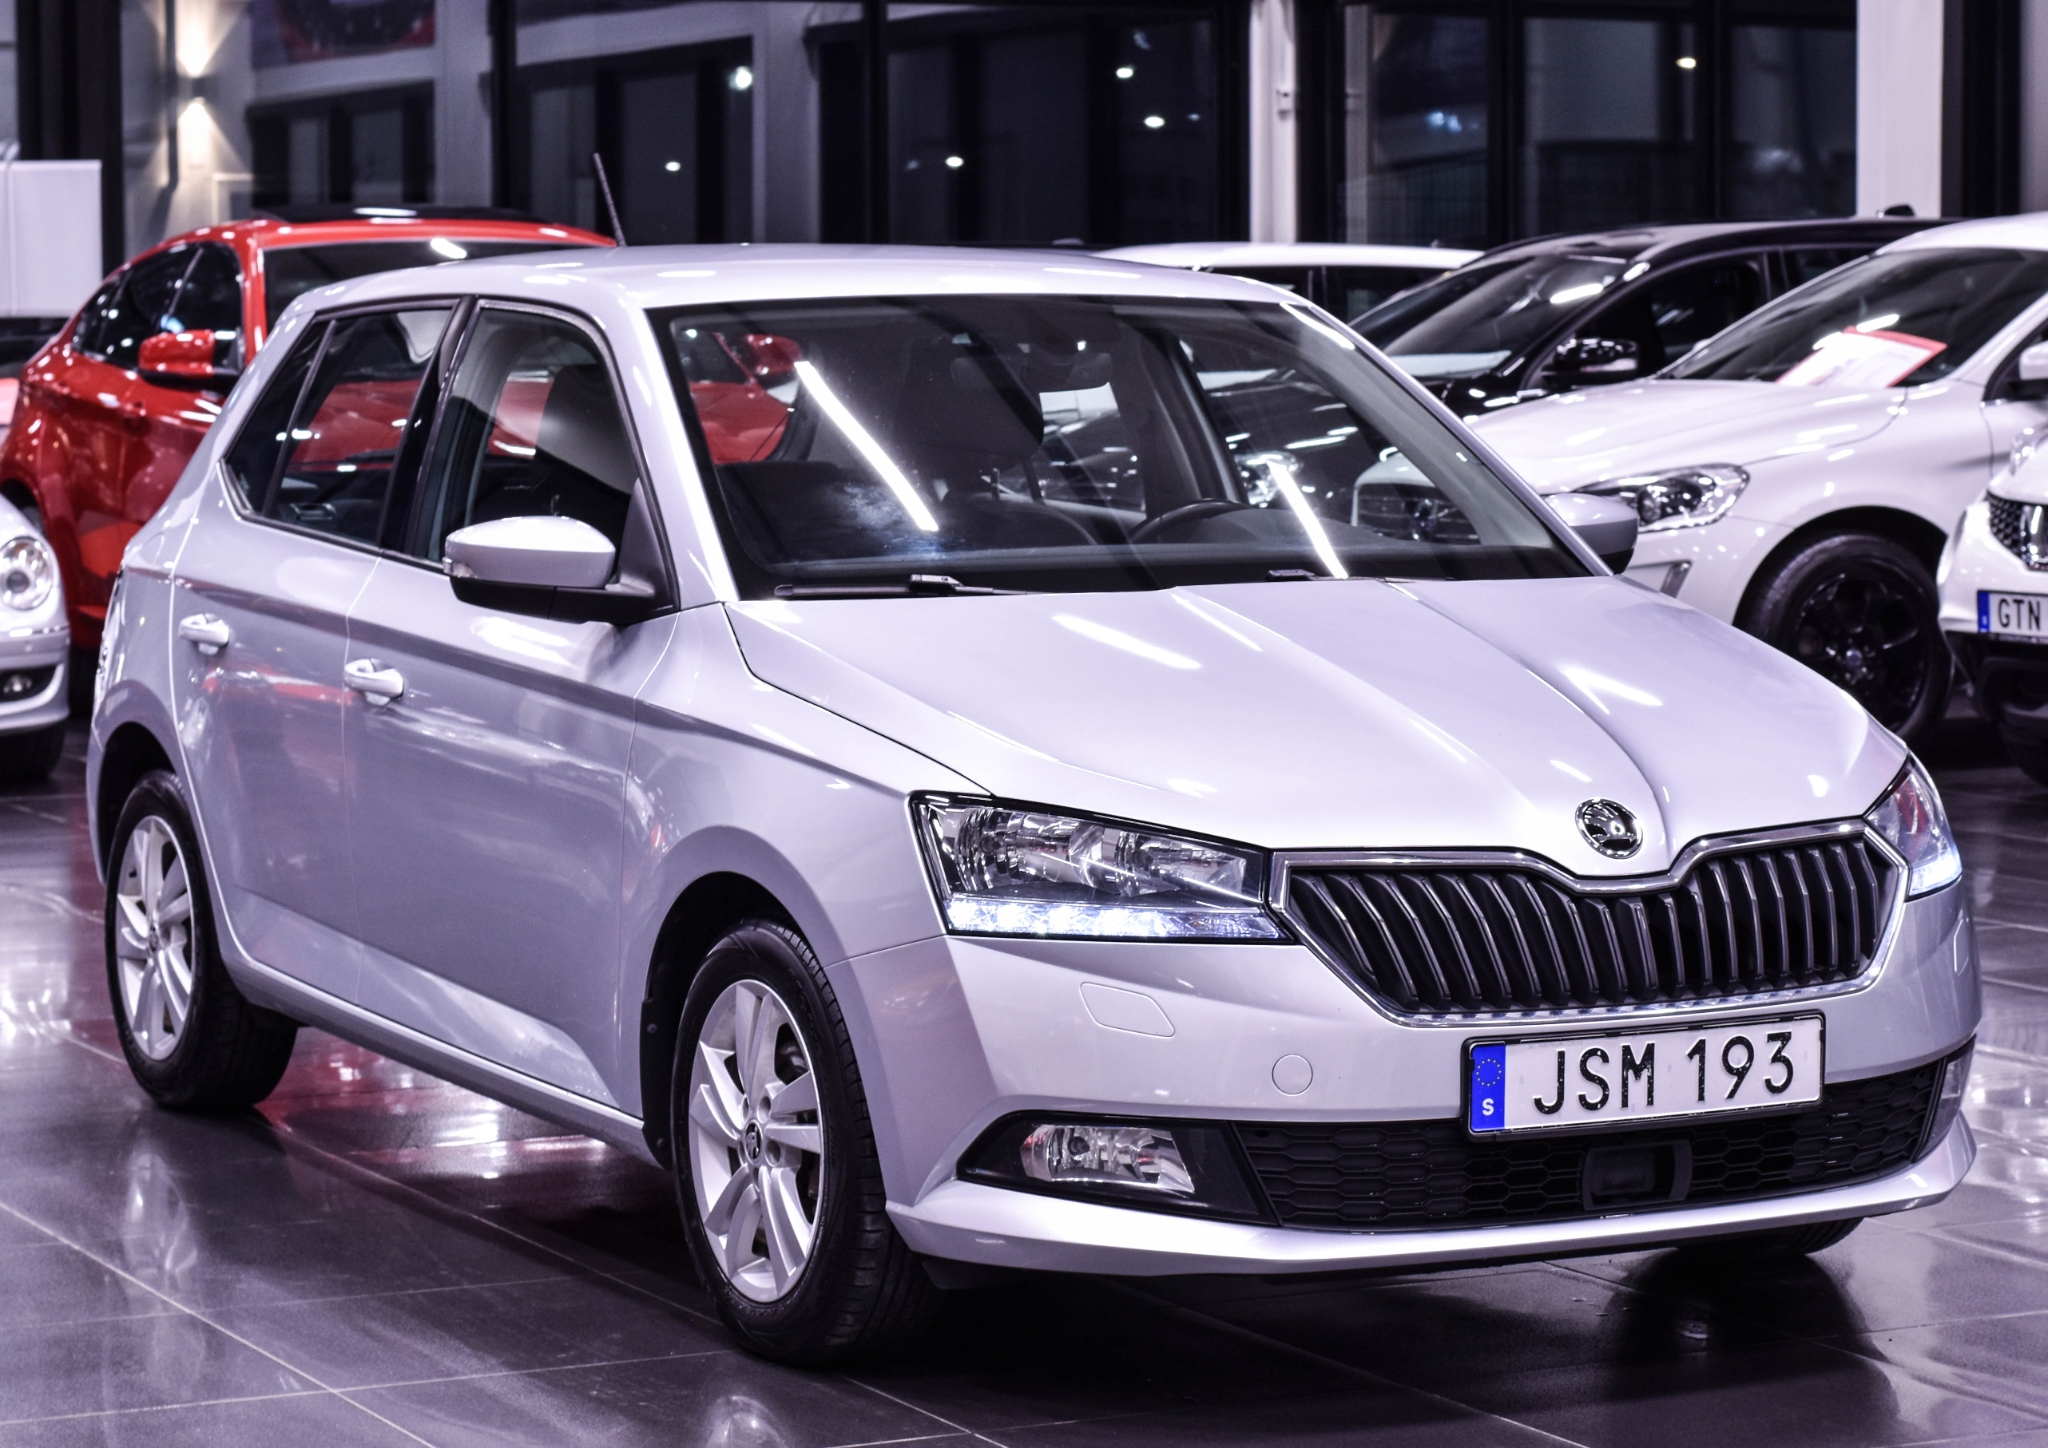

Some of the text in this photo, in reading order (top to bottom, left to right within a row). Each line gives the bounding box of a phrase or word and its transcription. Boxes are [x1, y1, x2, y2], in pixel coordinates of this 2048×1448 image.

[1998, 598, 2041, 631] GTN
[1533, 1031, 1794, 1115] JSM 193
[1482, 1098, 1494, 1116] S
